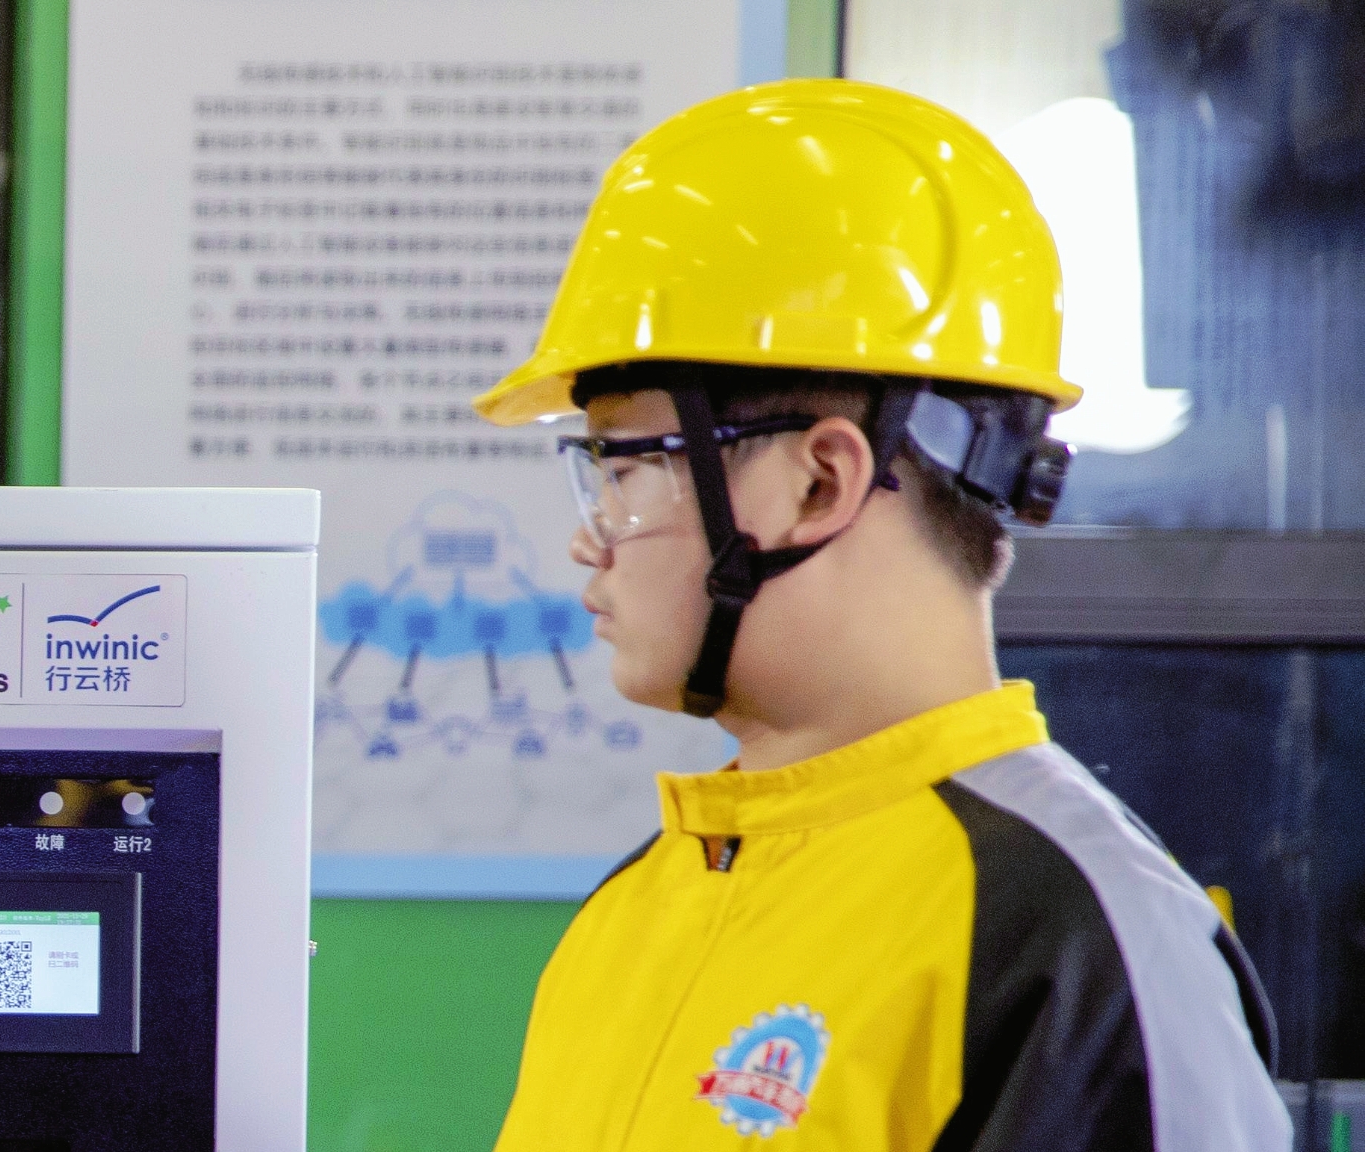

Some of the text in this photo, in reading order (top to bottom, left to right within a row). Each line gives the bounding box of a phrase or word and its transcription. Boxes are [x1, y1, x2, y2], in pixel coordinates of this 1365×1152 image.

[45, 633, 159, 661] inwinic
[45, 665, 131, 692] 行云桥
[35, 834, 65, 851] 故障
[113, 836, 152, 853] 运行2
